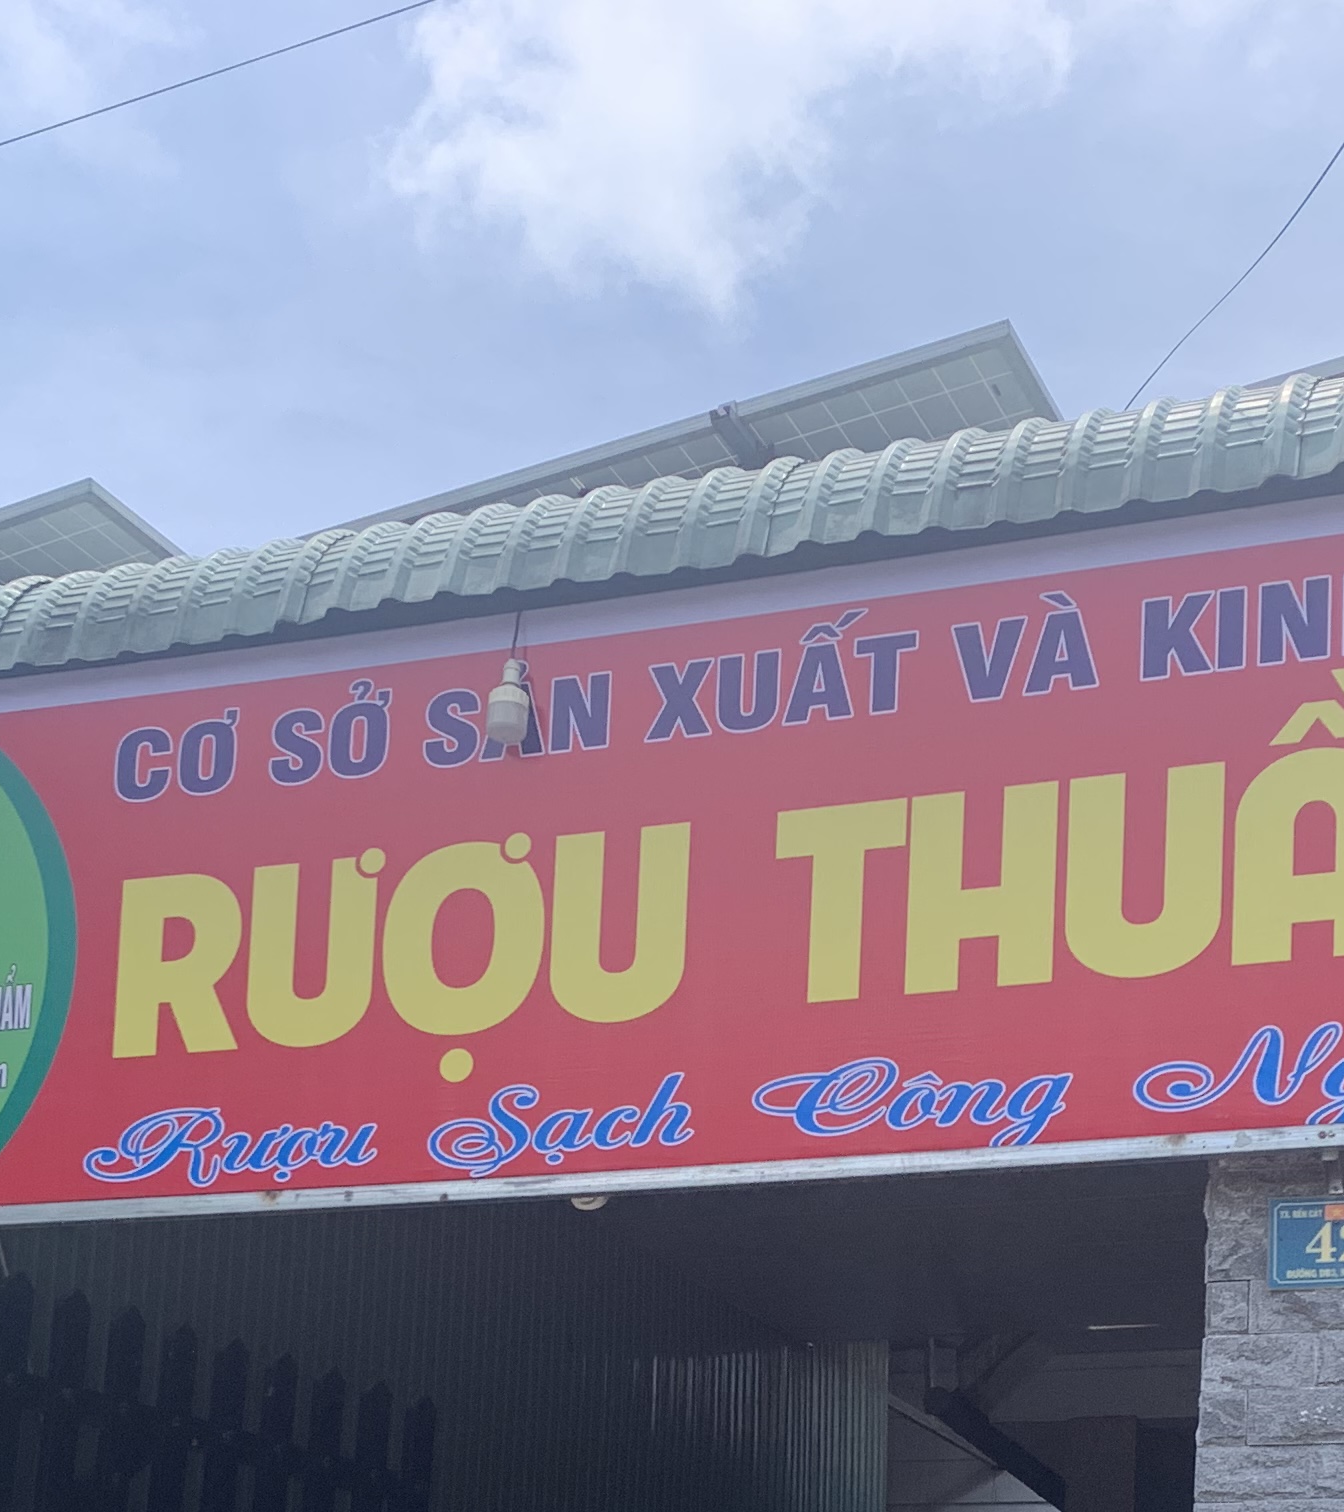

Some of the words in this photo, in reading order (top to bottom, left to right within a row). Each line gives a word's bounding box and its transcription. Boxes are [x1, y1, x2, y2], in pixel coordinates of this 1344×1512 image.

[113, 707, 241, 803] CƠ
[268, 678, 392, 787] SỞ
[643, 607, 918, 743] XUẤT
[952, 592, 1099, 704] VÀ
[111, 821, 691, 1084] RƯỢU
[83, 1106, 378, 1189] Rượu
[428, 1071, 695, 1178] Sạch
[751, 1057, 1074, 1148] Công
